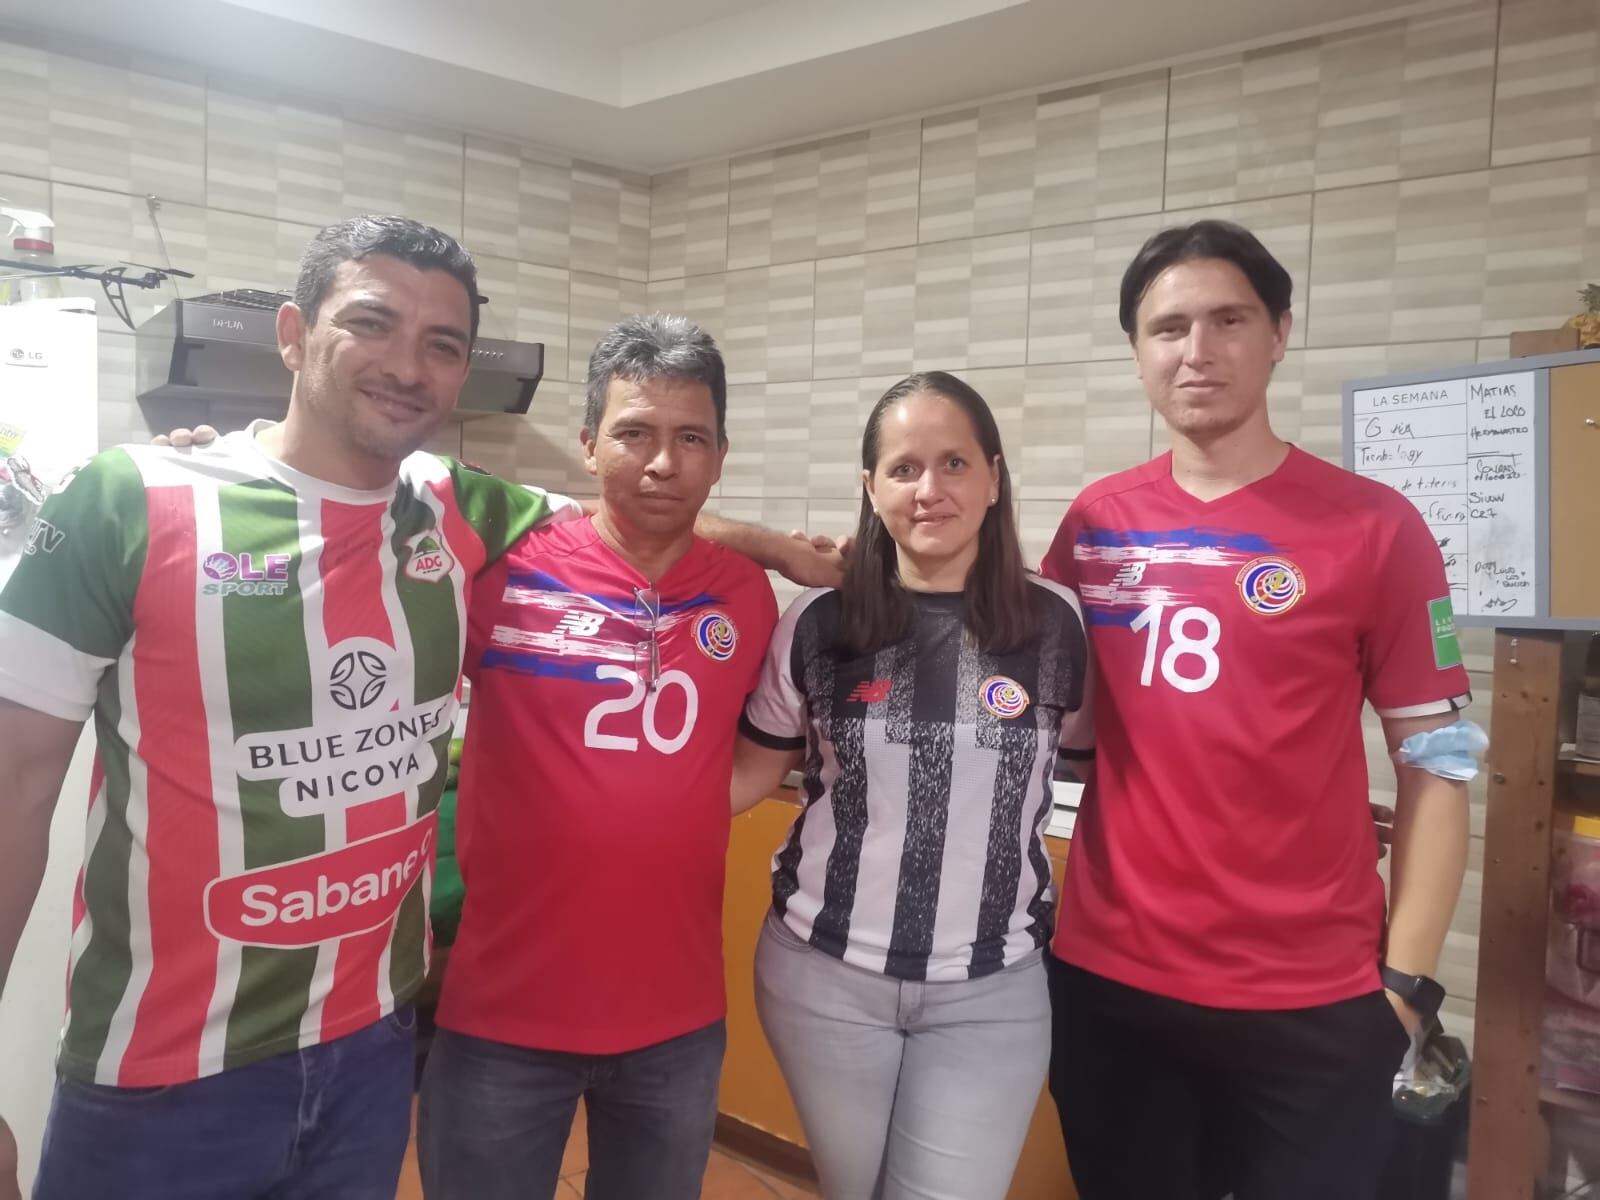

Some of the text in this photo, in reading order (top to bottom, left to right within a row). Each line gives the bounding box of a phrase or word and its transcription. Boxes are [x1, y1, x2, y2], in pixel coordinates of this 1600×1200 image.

[28, 352, 43, 360] LG
[1373, 389, 1449, 408] LA SEMANA
[203, 552, 291, 581] OLE
[203, 582, 288, 597] SPORT
[1129, 603, 1221, 693] 18
[584, 664, 699, 755] 20
[248, 703, 449, 769] BLUE ZONES
[296, 753, 420, 802] NICOYA
